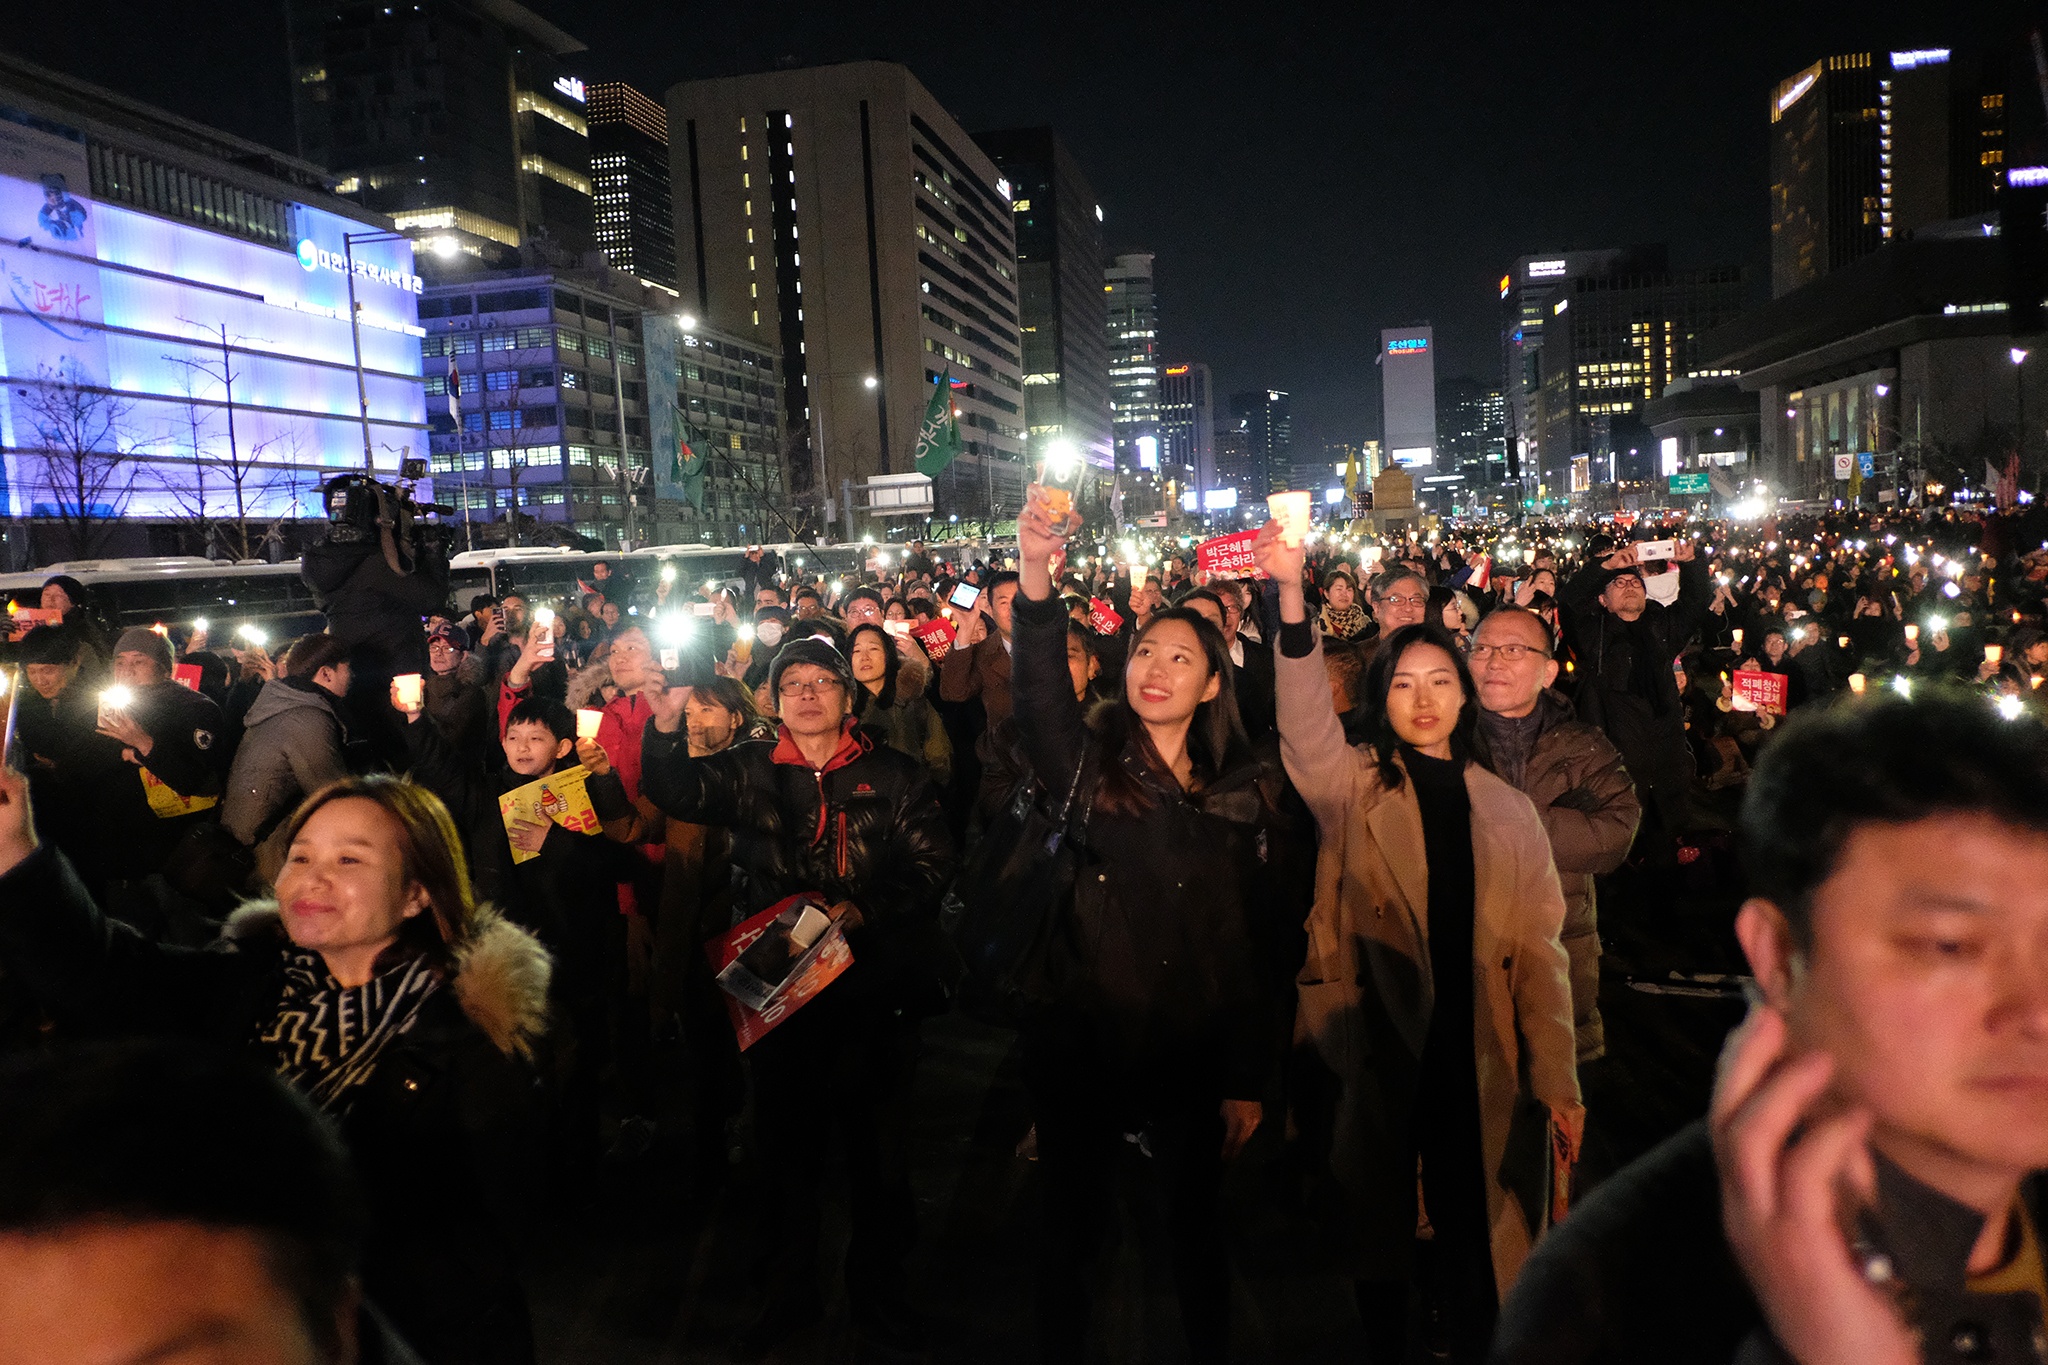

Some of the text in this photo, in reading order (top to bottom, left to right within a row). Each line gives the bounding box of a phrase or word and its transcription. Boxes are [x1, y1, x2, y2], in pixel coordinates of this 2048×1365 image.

[1387, 338, 1428, 350] 조선일보
[1206, 539, 1253, 557] 박근혜를
[1208, 552, 1255, 571] 구속하라
[1741, 678, 1781, 693] 적폐청산
[1741, 690, 1780, 704] 정권교체
